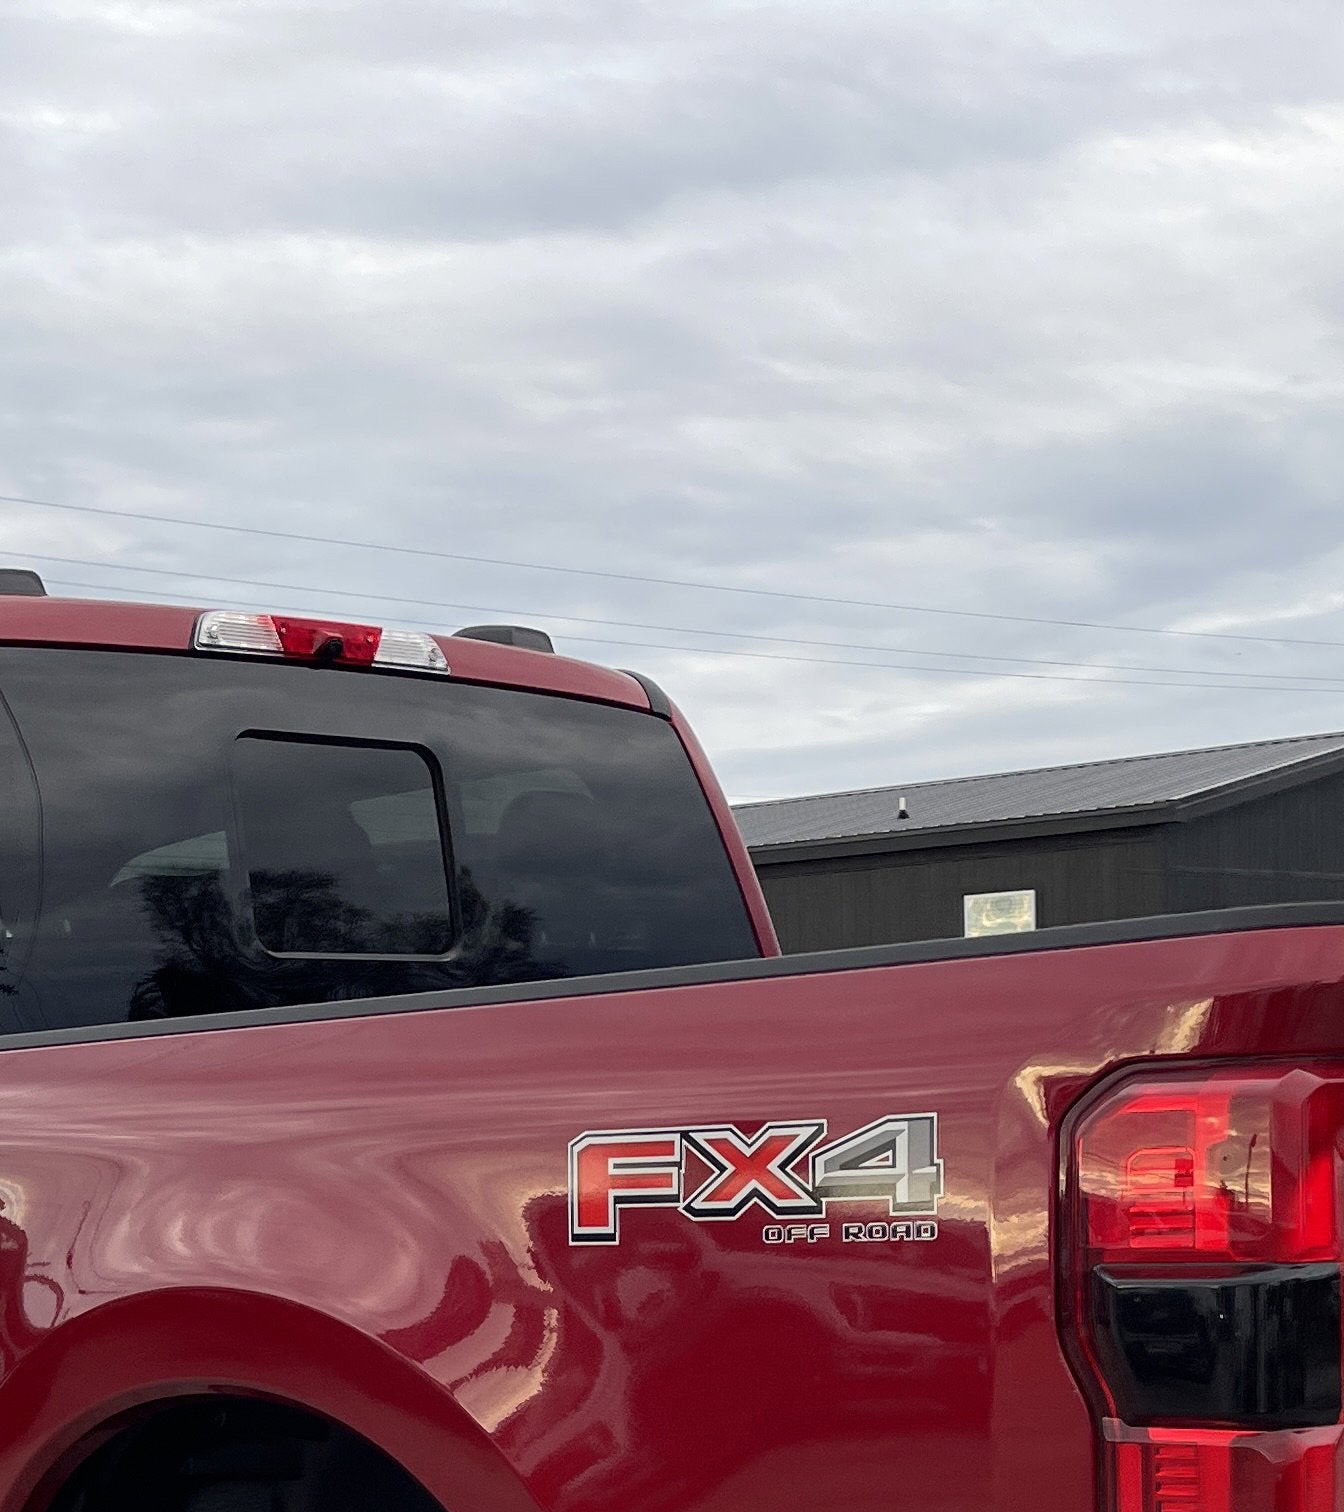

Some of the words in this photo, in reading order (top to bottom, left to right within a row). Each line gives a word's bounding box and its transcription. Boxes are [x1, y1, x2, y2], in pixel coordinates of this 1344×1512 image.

[568, 1112, 944, 1245] FX4
[762, 1223, 831, 1244] OFF
[842, 1220, 939, 1242] ROAD
